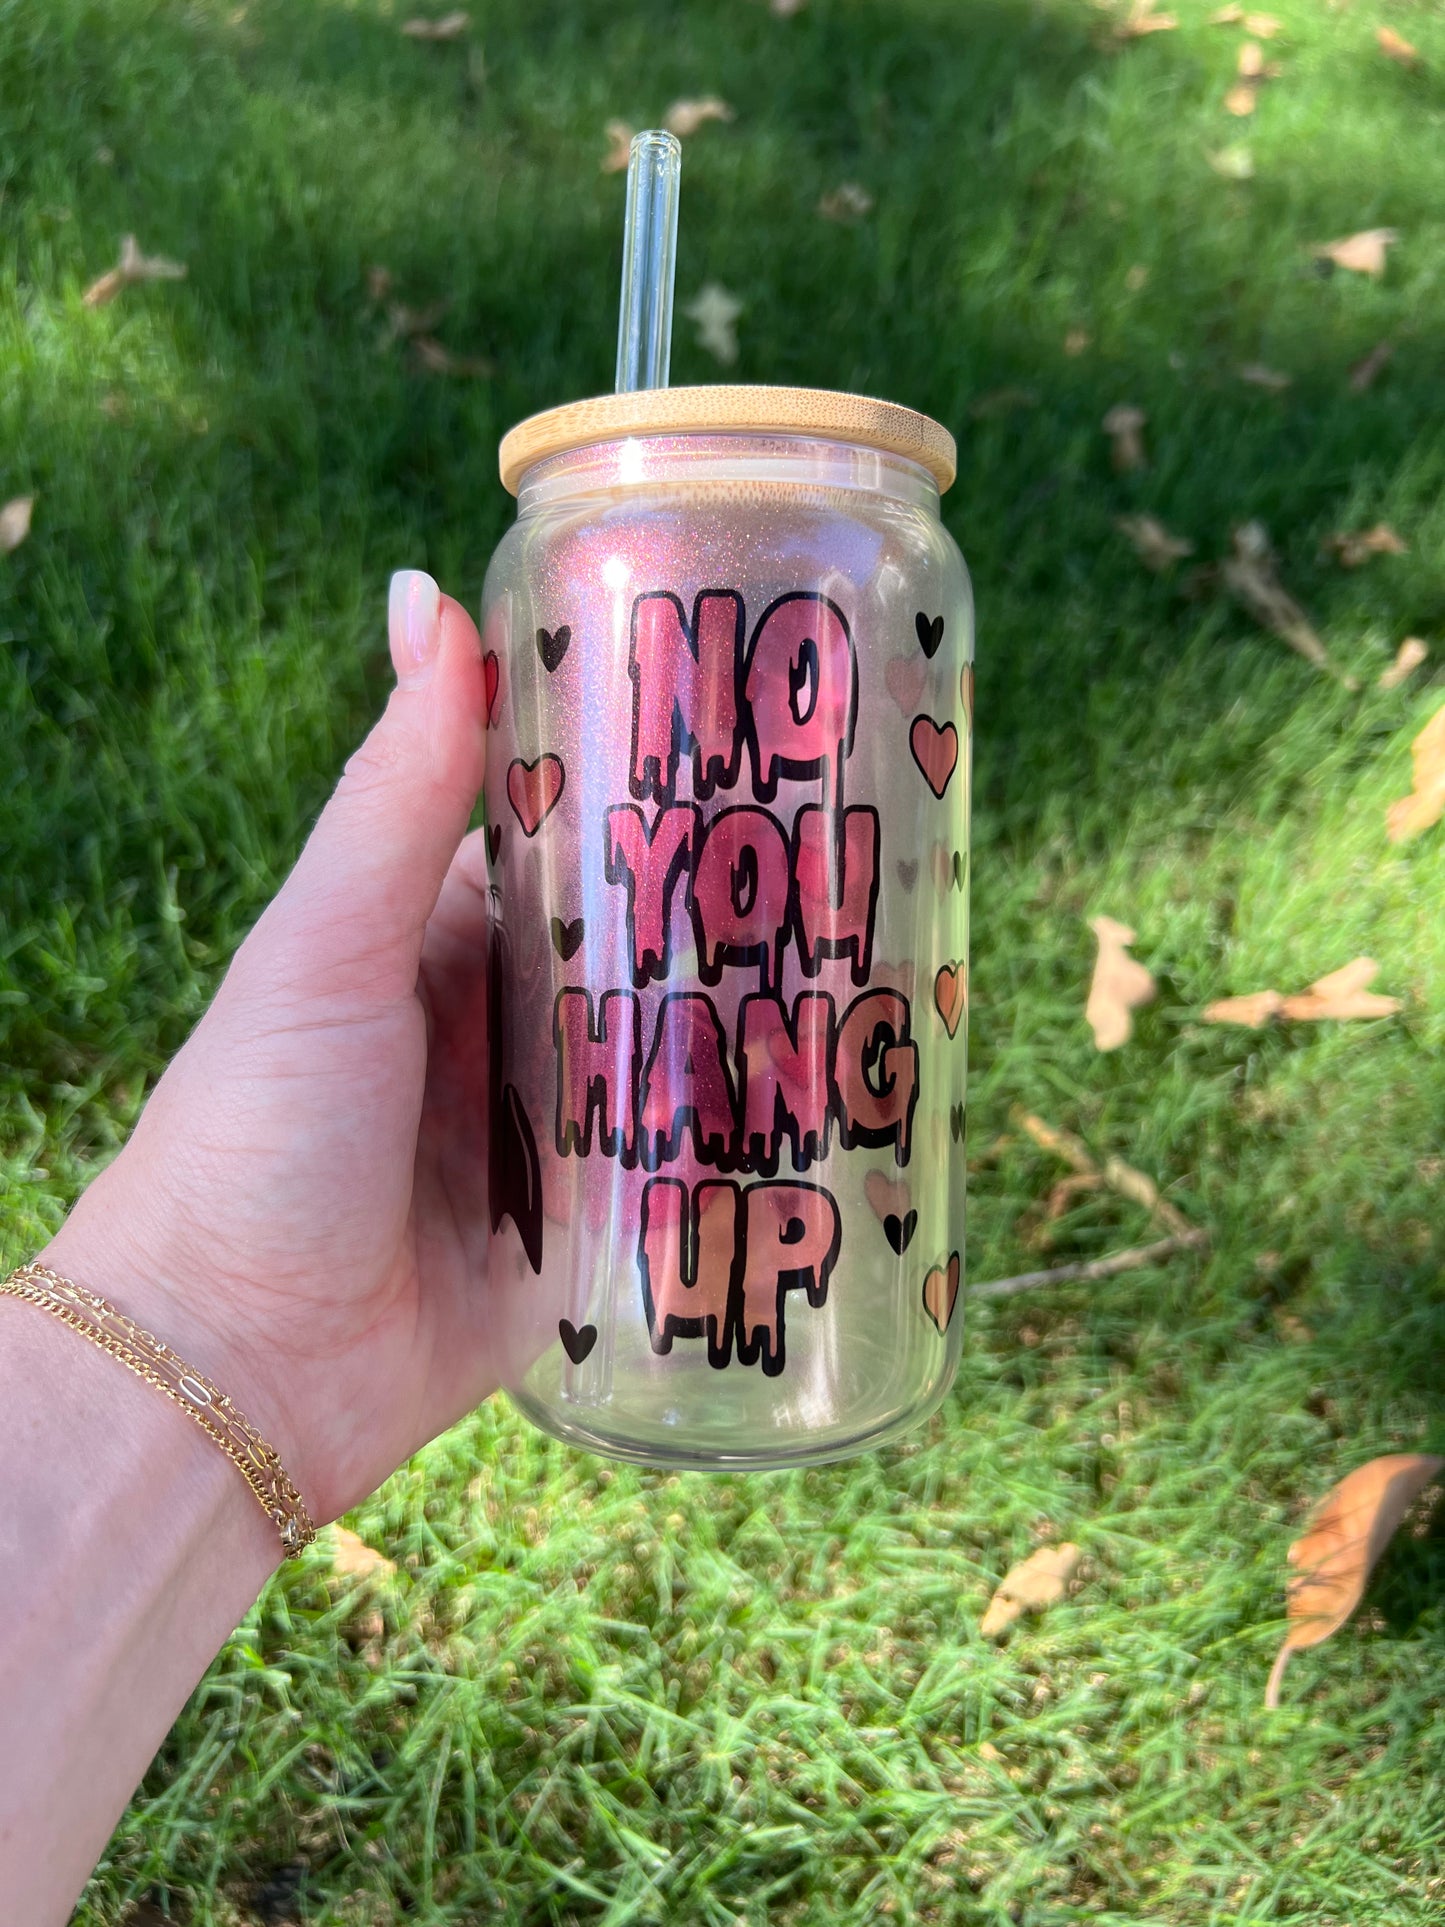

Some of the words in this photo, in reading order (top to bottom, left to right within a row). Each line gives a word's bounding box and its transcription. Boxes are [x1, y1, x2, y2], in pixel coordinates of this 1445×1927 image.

[628, 589, 859, 806] NO
[603, 801, 881, 989] YOU
[553, 986, 920, 1178] HANG
[637, 1176, 842, 1377] UP
